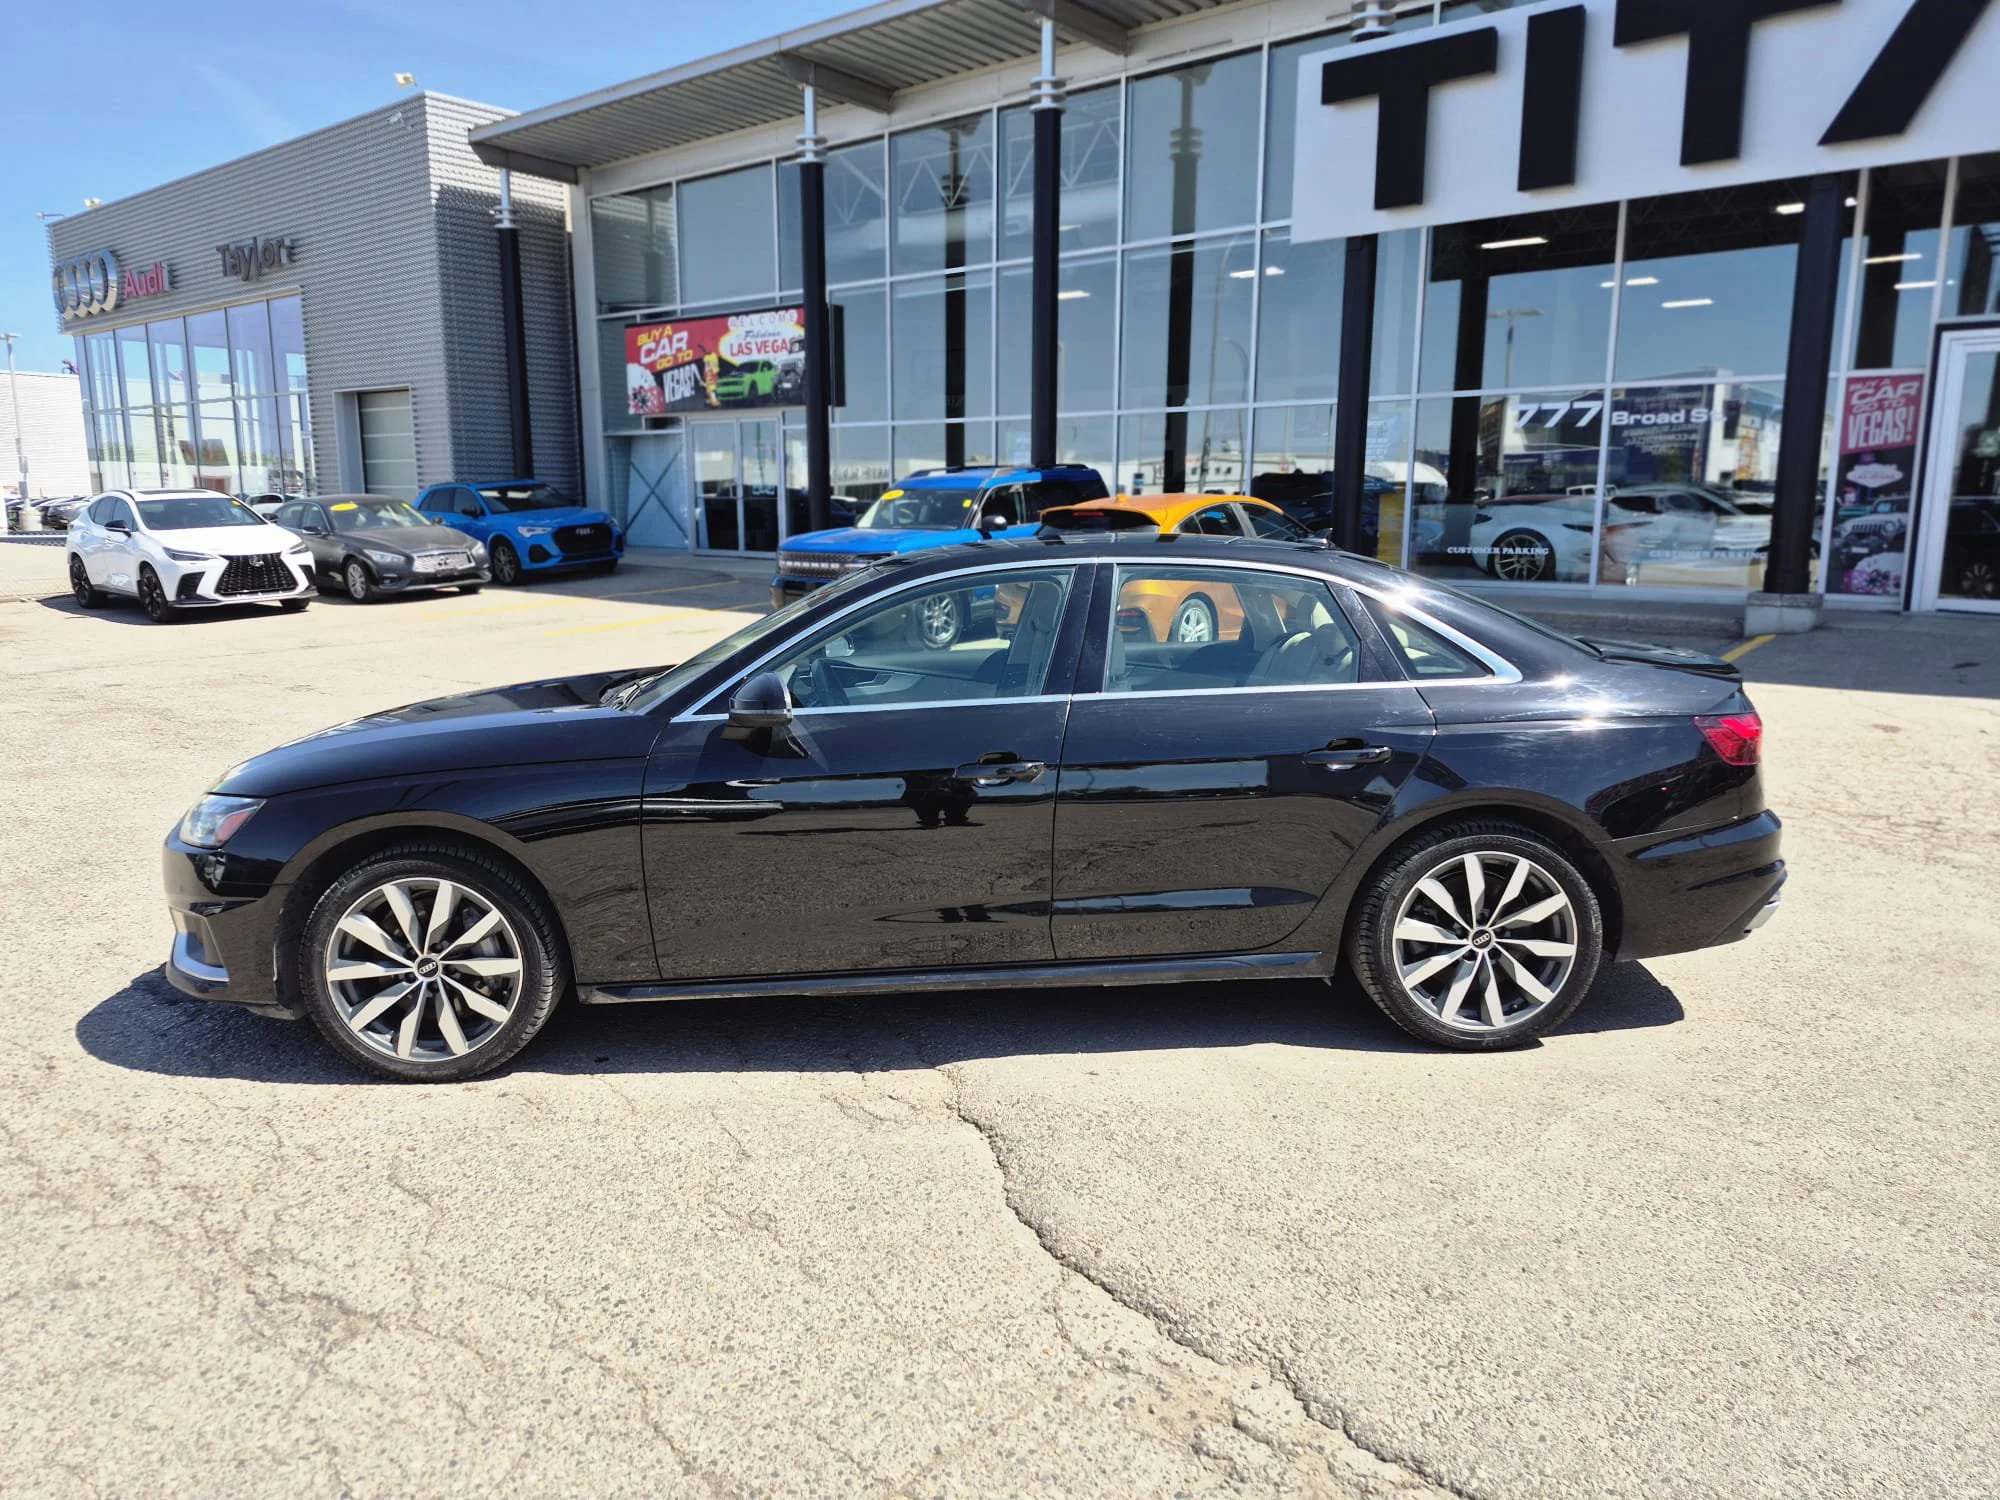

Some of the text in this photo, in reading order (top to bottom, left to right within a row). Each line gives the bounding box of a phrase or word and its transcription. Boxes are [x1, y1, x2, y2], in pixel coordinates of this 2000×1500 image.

[216, 236, 292, 282] Taylor
[124, 261, 169, 299] Audi
[637, 324, 672, 347] BUY A
[640, 330, 688, 364] CAR
[656, 349, 693, 371] GO TO
[730, 341, 753, 357] LAS
[1851, 381, 1921, 406] CAR
[1513, 401, 1603, 428] 777
[1611, 409, 1686, 426] Broad
[1847, 405, 1915, 449] VEGAS!
[1447, 546, 1549, 555] CUSTOMER PARKING
